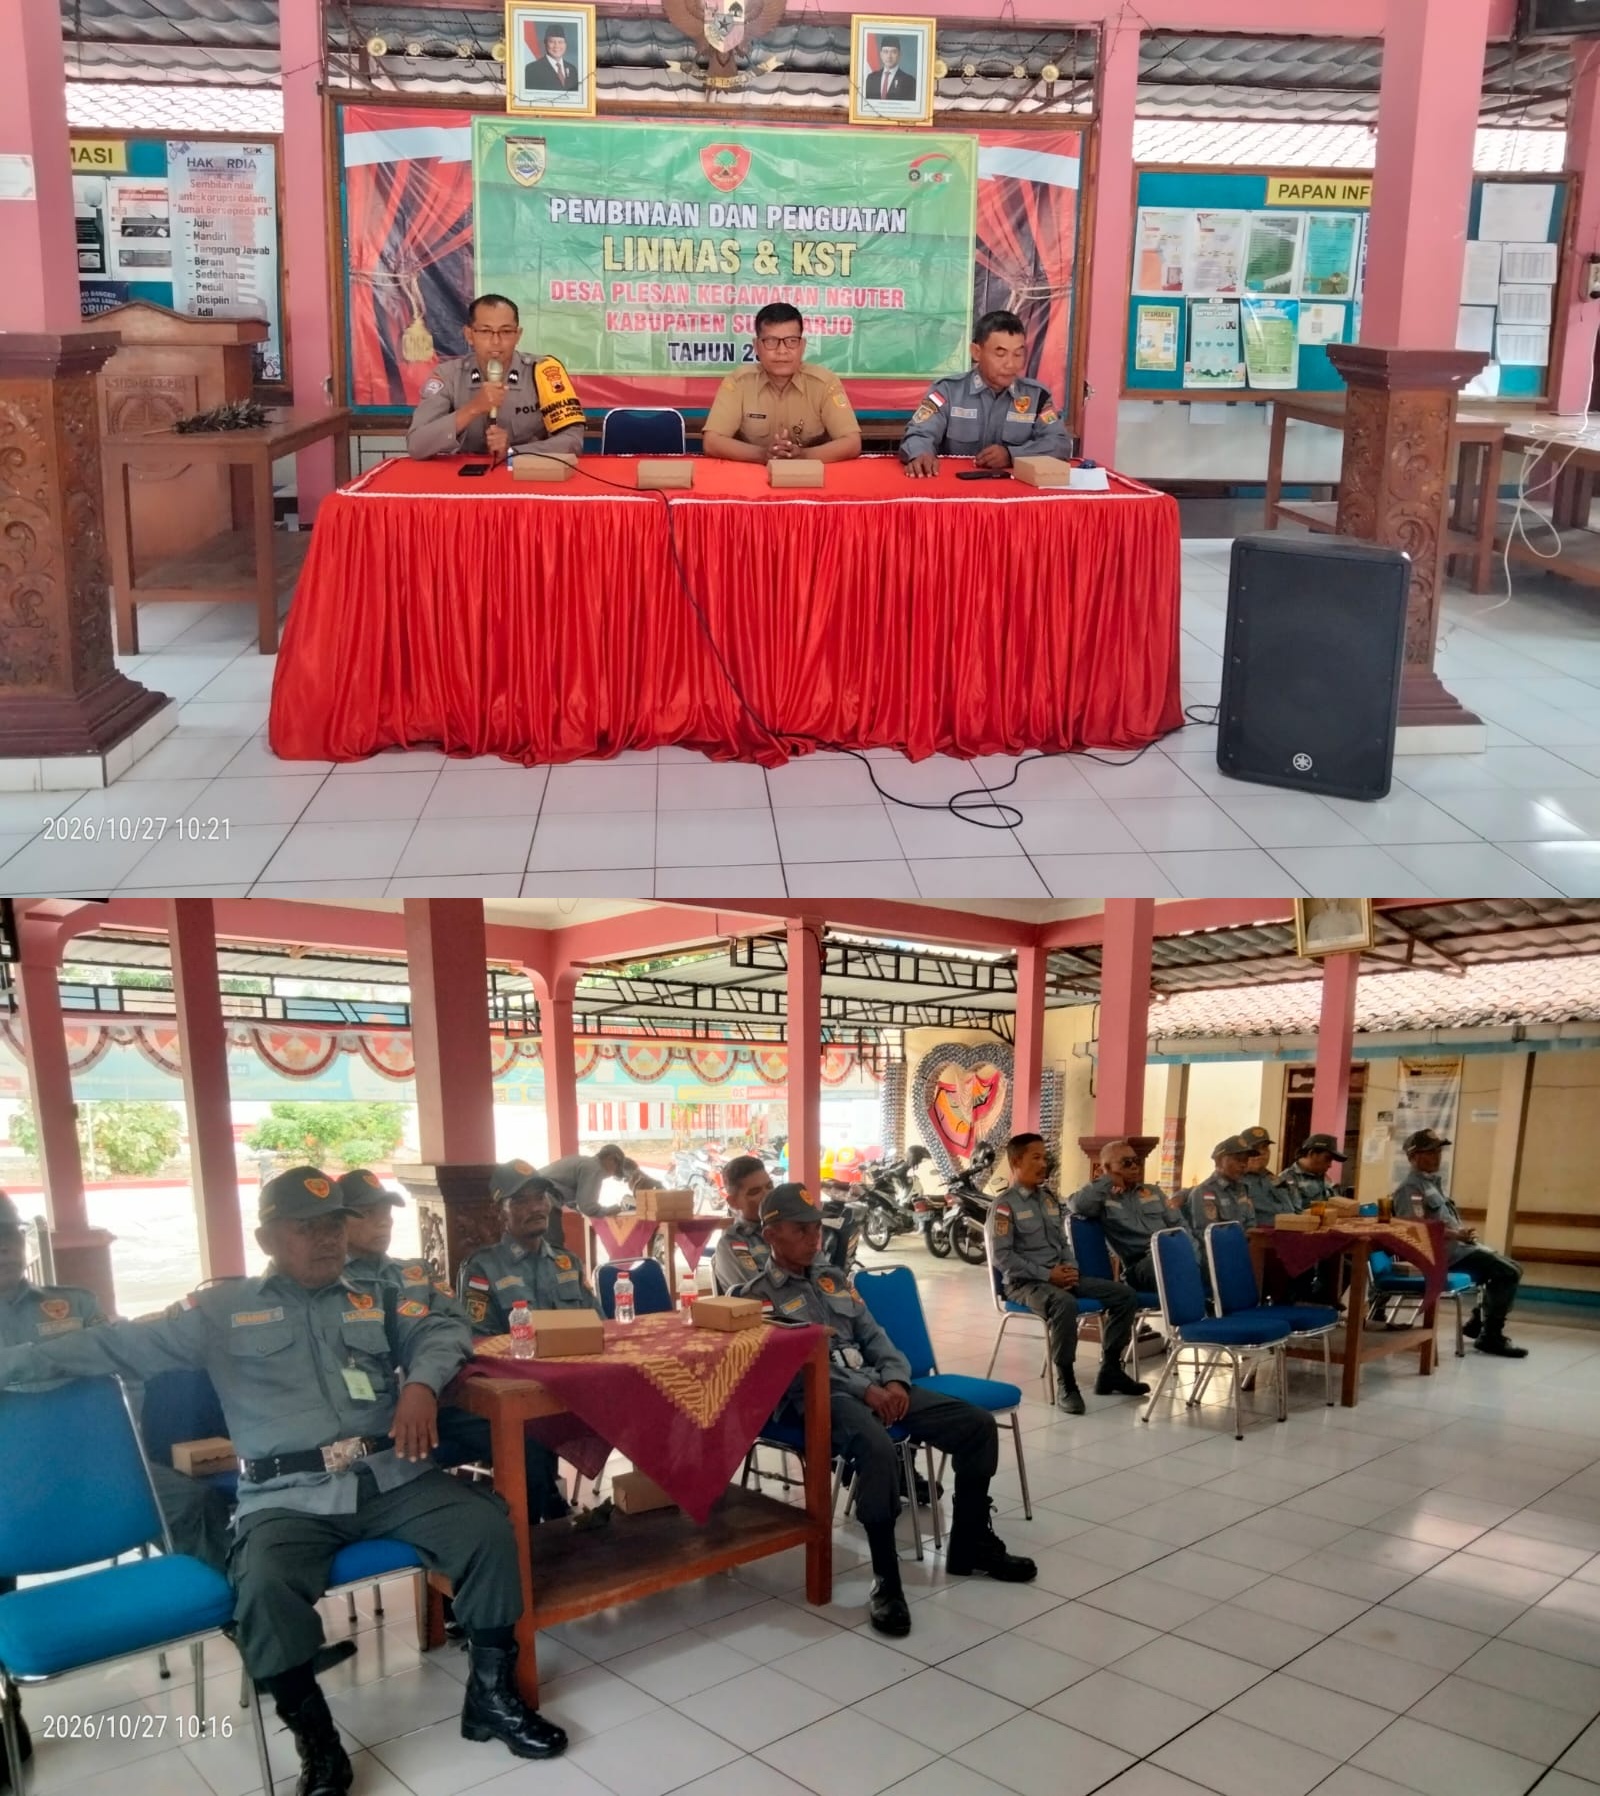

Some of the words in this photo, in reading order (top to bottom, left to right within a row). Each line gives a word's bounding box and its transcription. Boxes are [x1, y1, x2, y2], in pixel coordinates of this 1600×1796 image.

[924, 172, 952, 183] KST
[190, 179, 232, 189] Sembilan
[1278, 184, 1337, 199] PAPAN
[238, 195, 267, 203] dalam
[550, 198, 700, 228] PEMBINAAN
[709, 203, 758, 230] DAN
[767, 205, 907, 233] PENGUATAN
[193, 218, 214, 229] Jujur
[193, 231, 227, 241] Mandiri
[194, 244, 241, 256] Tanggung
[243, 246, 270, 255] Jawab
[194, 257, 224, 266] Berani
[603, 235, 741, 275] LINMAS
[753, 239, 780, 275] &
[792, 240, 858, 277] KST
[195, 270, 246, 280] Sederhana
[196, 282, 224, 291] Peduli
[550, 280, 605, 301] DESA
[611, 282, 689, 304] PLESAN
[697, 285, 819, 307] KECAMATAN
[823, 287, 905, 309] NGUTER
[196, 295, 230, 306] Disiplin
[197, 308, 214, 317] Adil
[606, 311, 725, 333] KABUPATEN
[732, 314, 854, 336] SUARJO
[668, 341, 735, 363] TAHUN
[742, 343, 761, 363] 2
